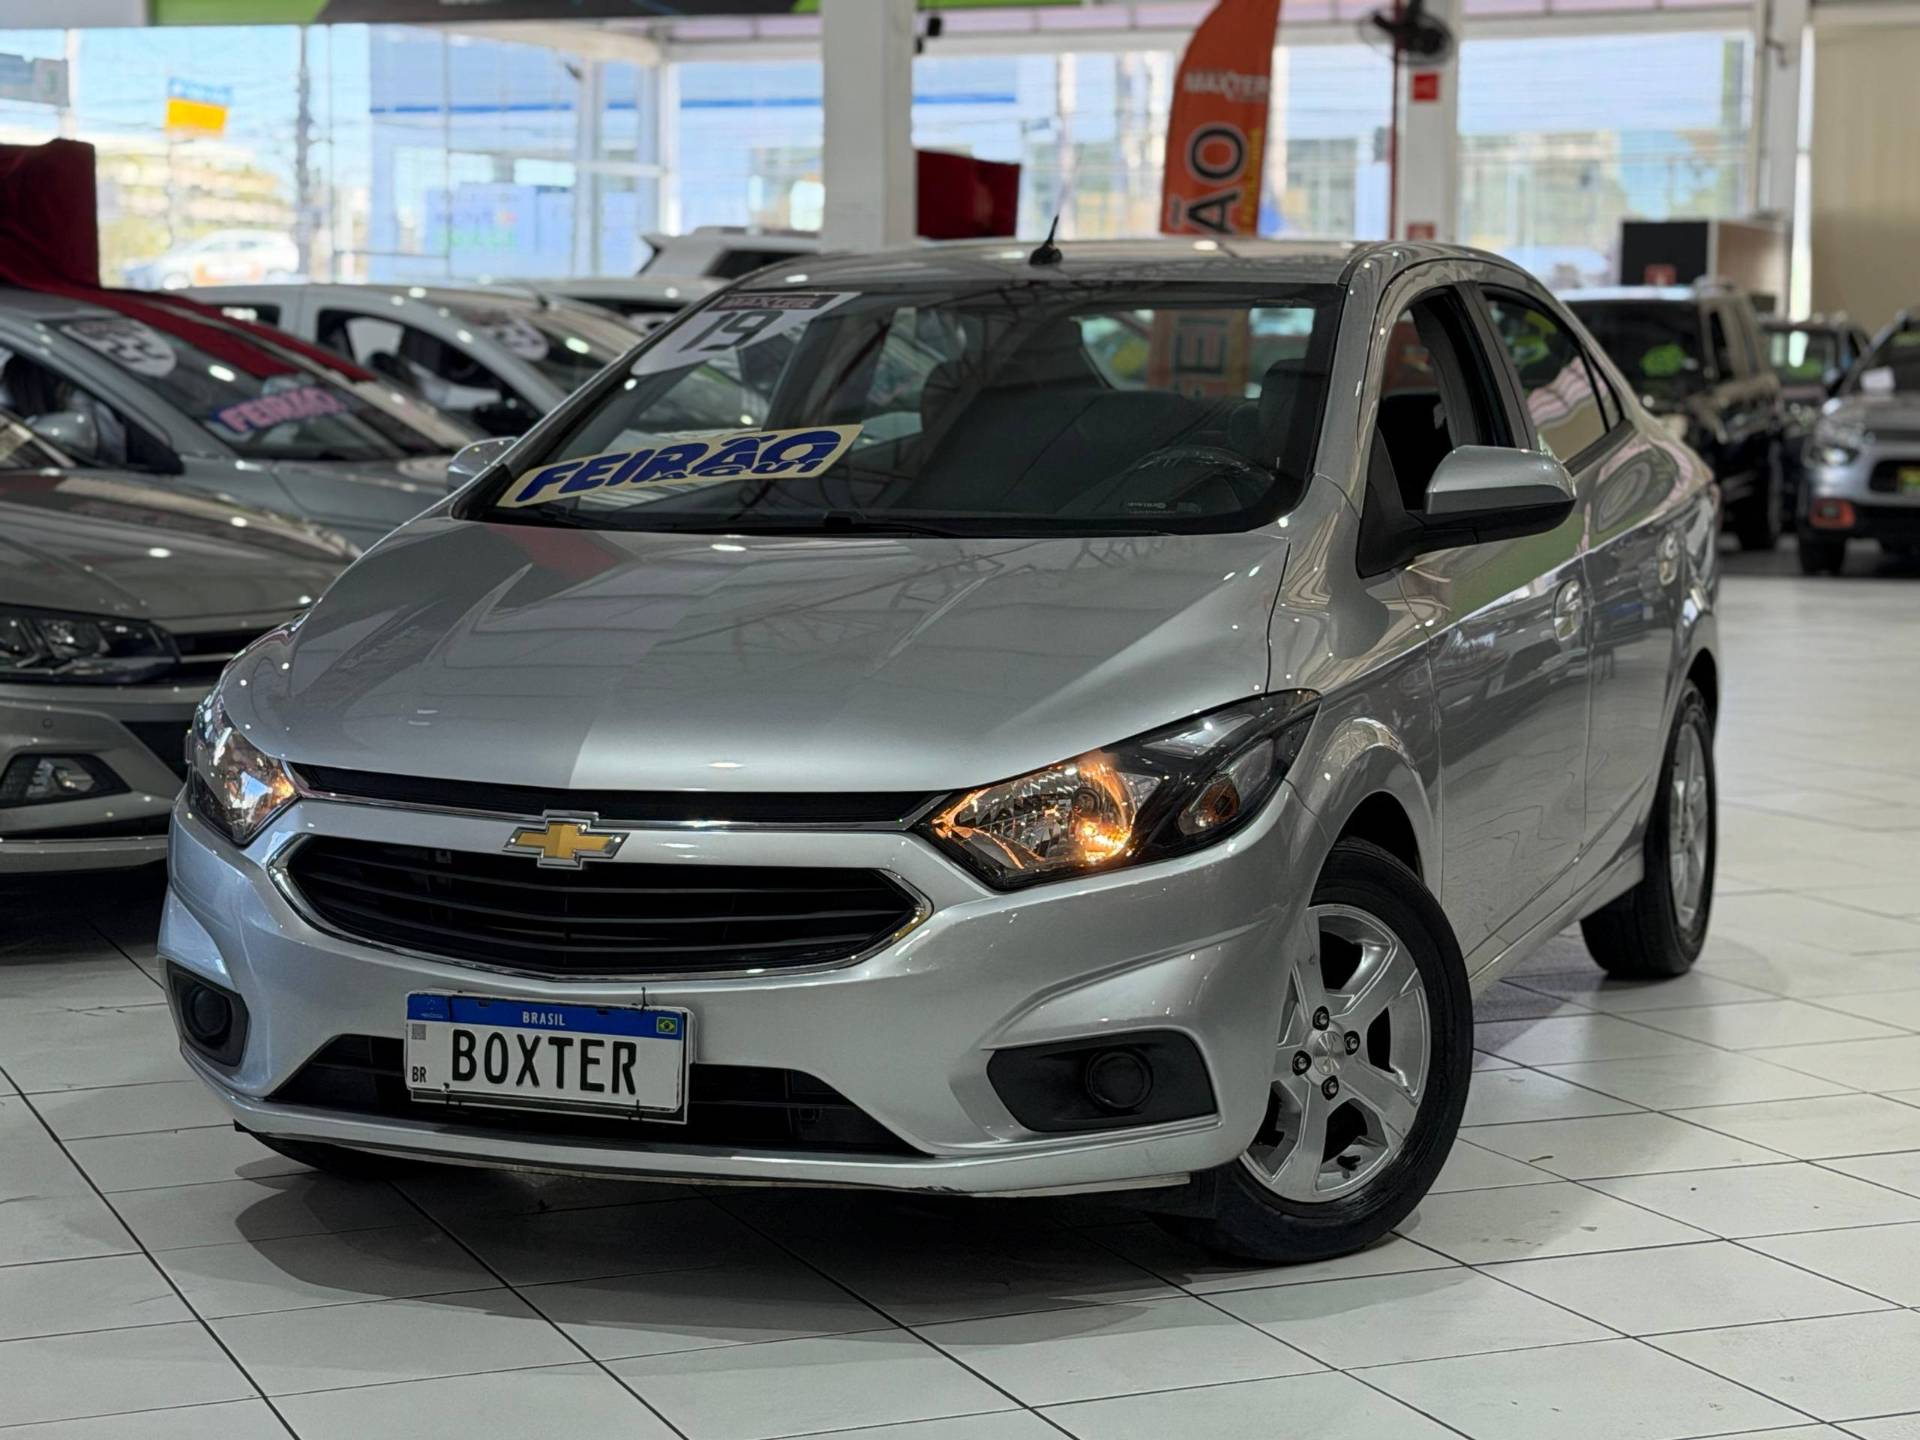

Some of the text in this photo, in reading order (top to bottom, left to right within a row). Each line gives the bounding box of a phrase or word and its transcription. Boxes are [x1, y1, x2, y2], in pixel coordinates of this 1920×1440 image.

[677, 311, 784, 352] 19
[514, 430, 842, 502] FEIRÃO
[522, 1011, 566, 1027] BRASIL
[411, 1066, 427, 1083] BR
[452, 1029, 637, 1095] BOXTER
